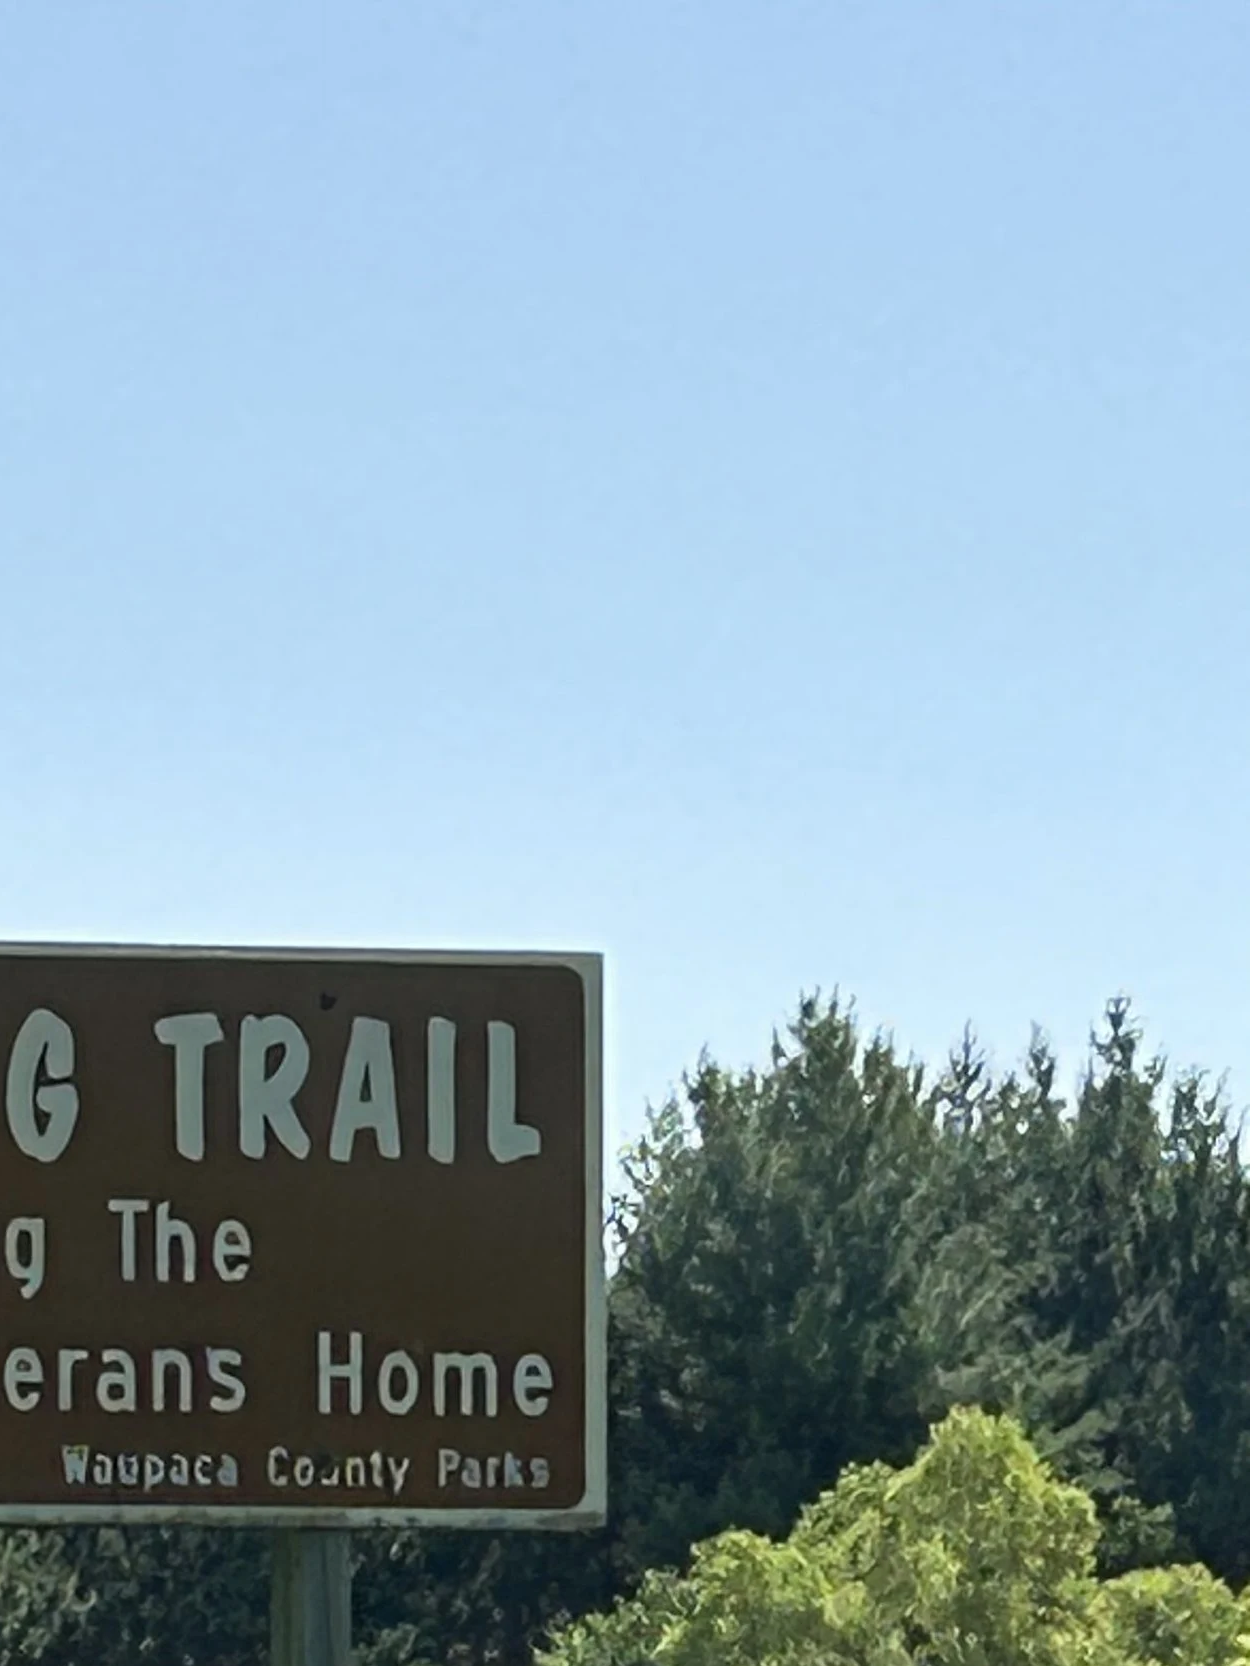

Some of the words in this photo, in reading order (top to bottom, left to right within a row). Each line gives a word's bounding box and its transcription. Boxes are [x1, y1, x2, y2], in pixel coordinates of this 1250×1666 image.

[154, 1012, 541, 1164] TRAIL
[108, 1199, 252, 1283] The
[318, 1331, 554, 1417] Home
[61, 1445, 238, 1491] Waupaca
[438, 1449, 550, 1488] Parks
